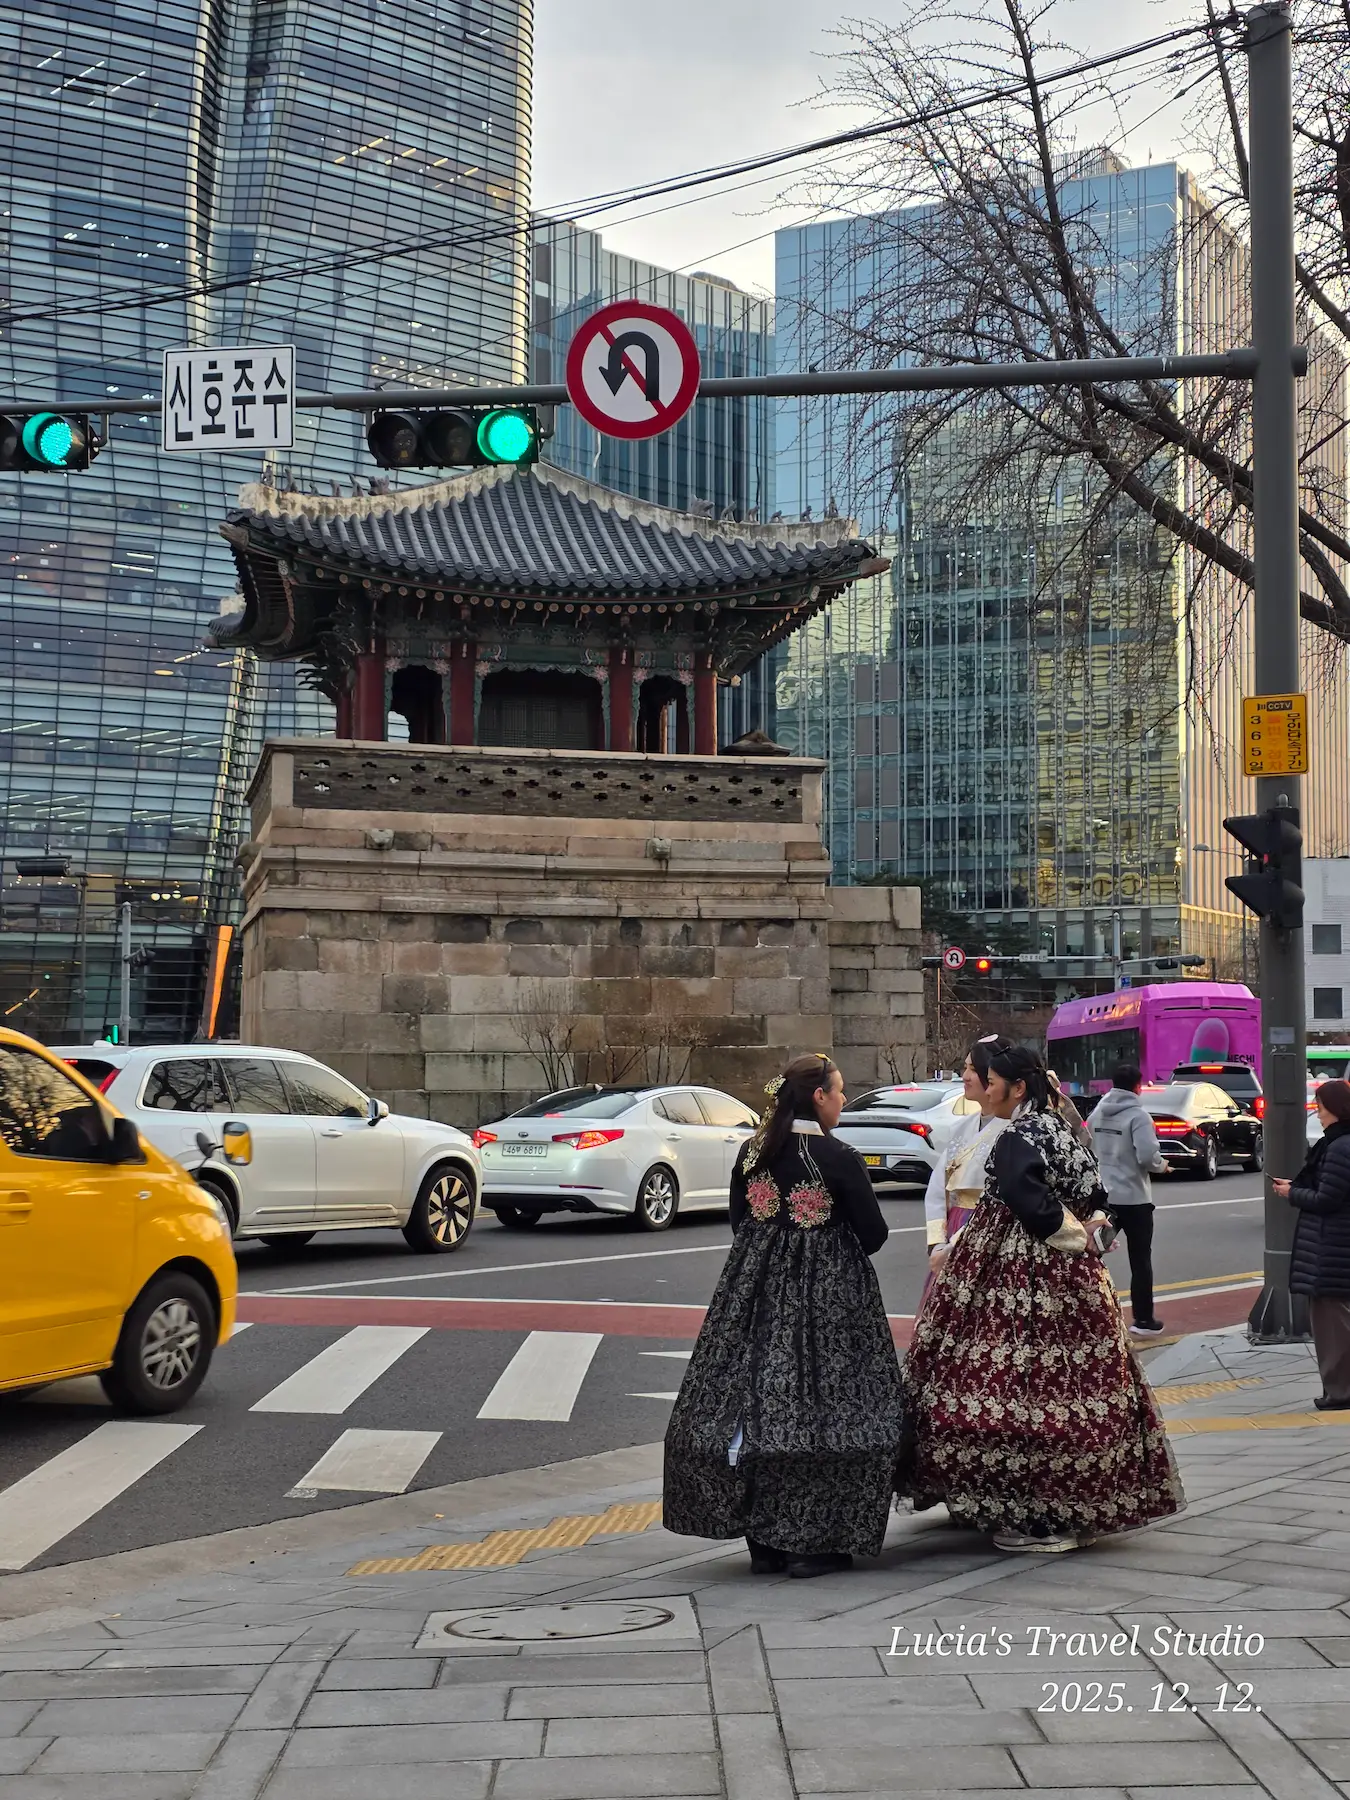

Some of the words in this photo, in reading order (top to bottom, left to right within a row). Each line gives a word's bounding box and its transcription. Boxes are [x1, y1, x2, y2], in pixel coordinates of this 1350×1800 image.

[169, 357, 288, 442] 신호준수
[1268, 702, 1291, 710] CCTV
[1287, 713, 1302, 770] 무인단속구간
[523, 1145, 543, 1155] 6810
